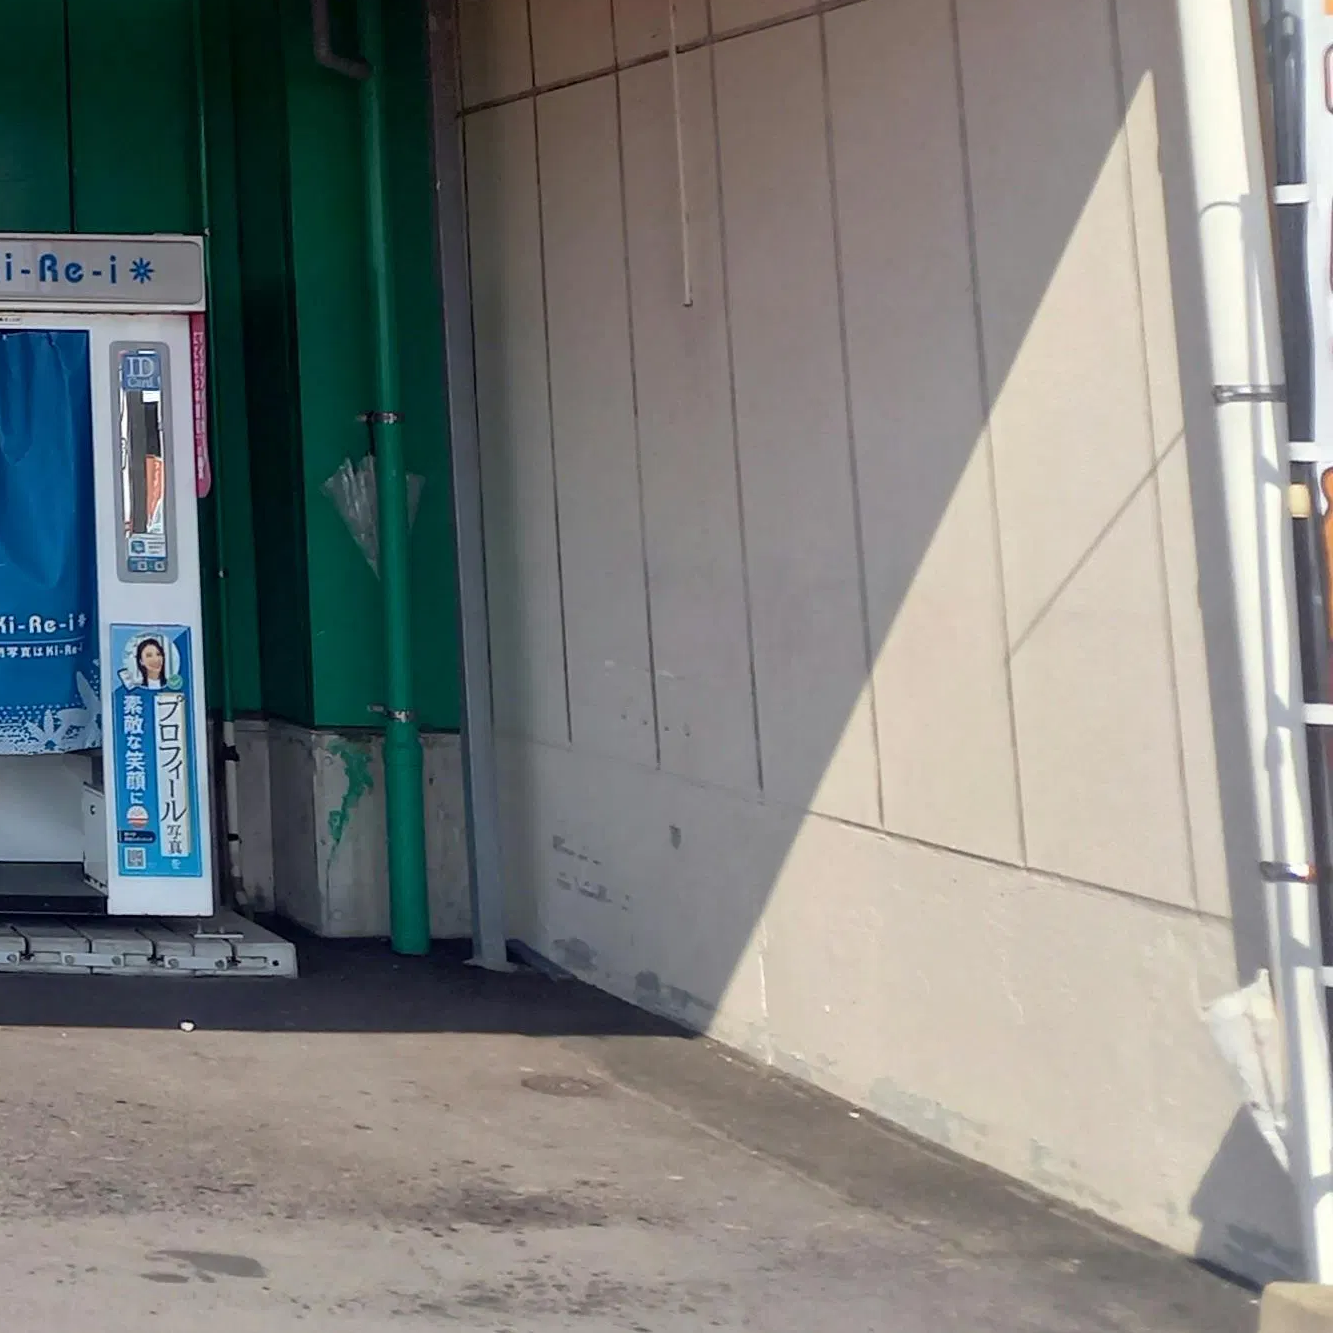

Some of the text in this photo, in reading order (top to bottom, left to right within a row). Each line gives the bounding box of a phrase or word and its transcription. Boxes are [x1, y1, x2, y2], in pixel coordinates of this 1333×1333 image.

[123, 695, 146, 805] 素敵な笑顔に
